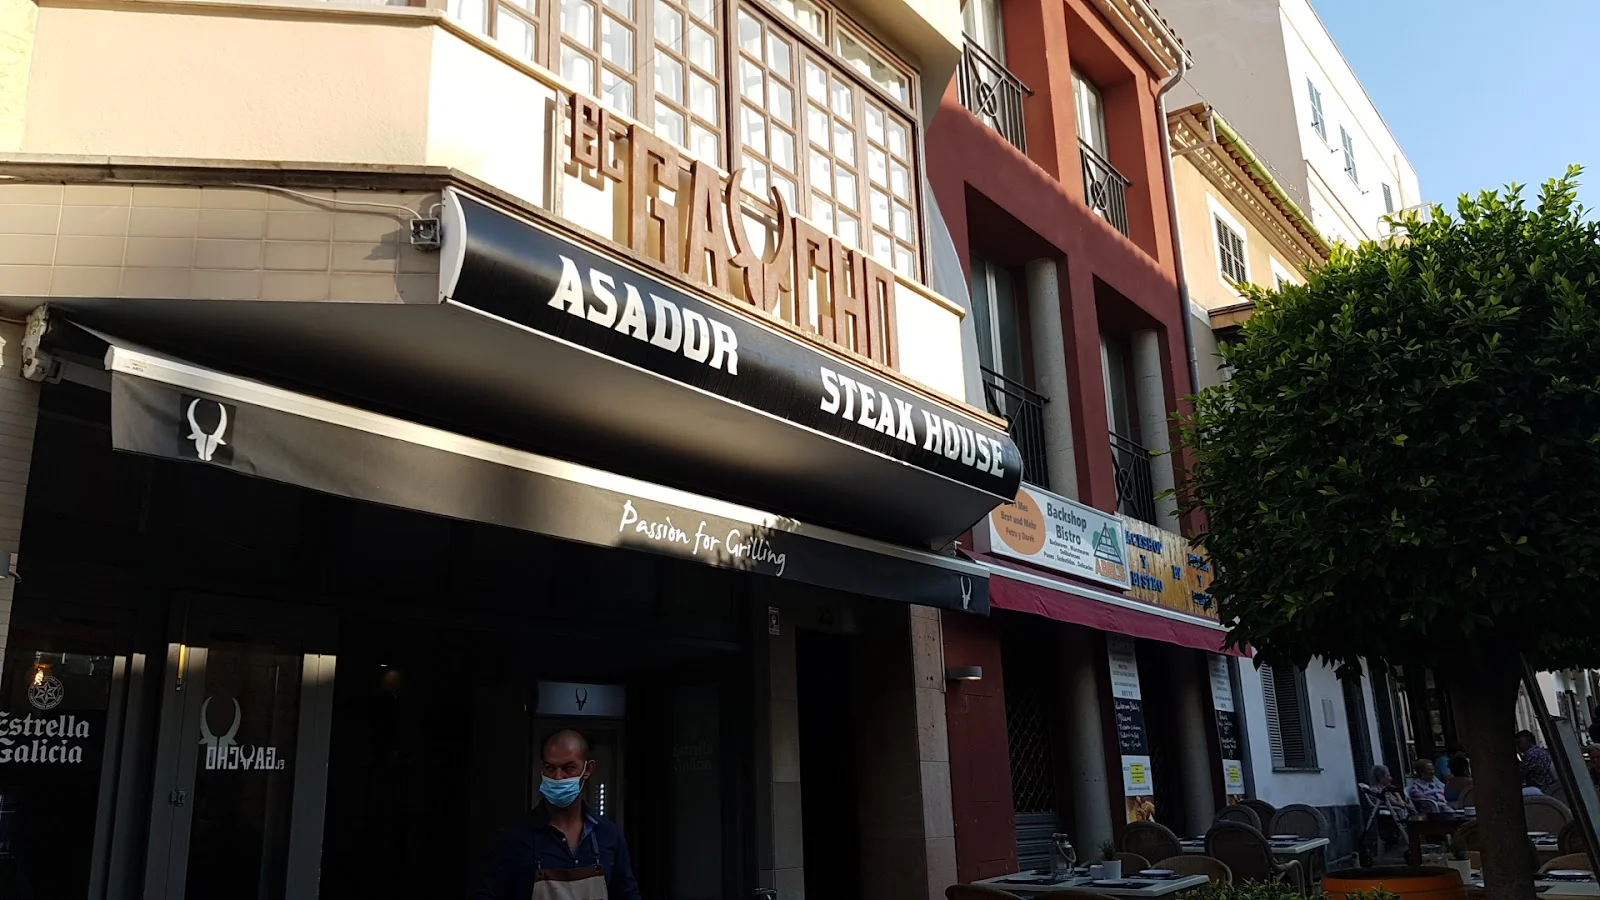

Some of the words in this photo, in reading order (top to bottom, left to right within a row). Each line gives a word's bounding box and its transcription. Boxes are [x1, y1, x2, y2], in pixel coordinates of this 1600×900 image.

[547, 254, 738, 376] ASADOR
[820, 366, 917, 446] STEAK
[921, 410, 1006, 478] HOUSE
[1013, 516, 1023, 526] und
[1023, 518, 1037, 530] Mehr
[1046, 502, 1087, 533] Backshop
[619, 499, 690, 544] Passion
[692, 520, 721, 555] for
[726, 528, 787, 577] Grilling
[1056, 524, 1081, 546] Bistro
[1130, 571, 1165, 593] BISTRO
[0, 711, 90, 739] Estrella
[0, 737, 83, 764] Galicia
